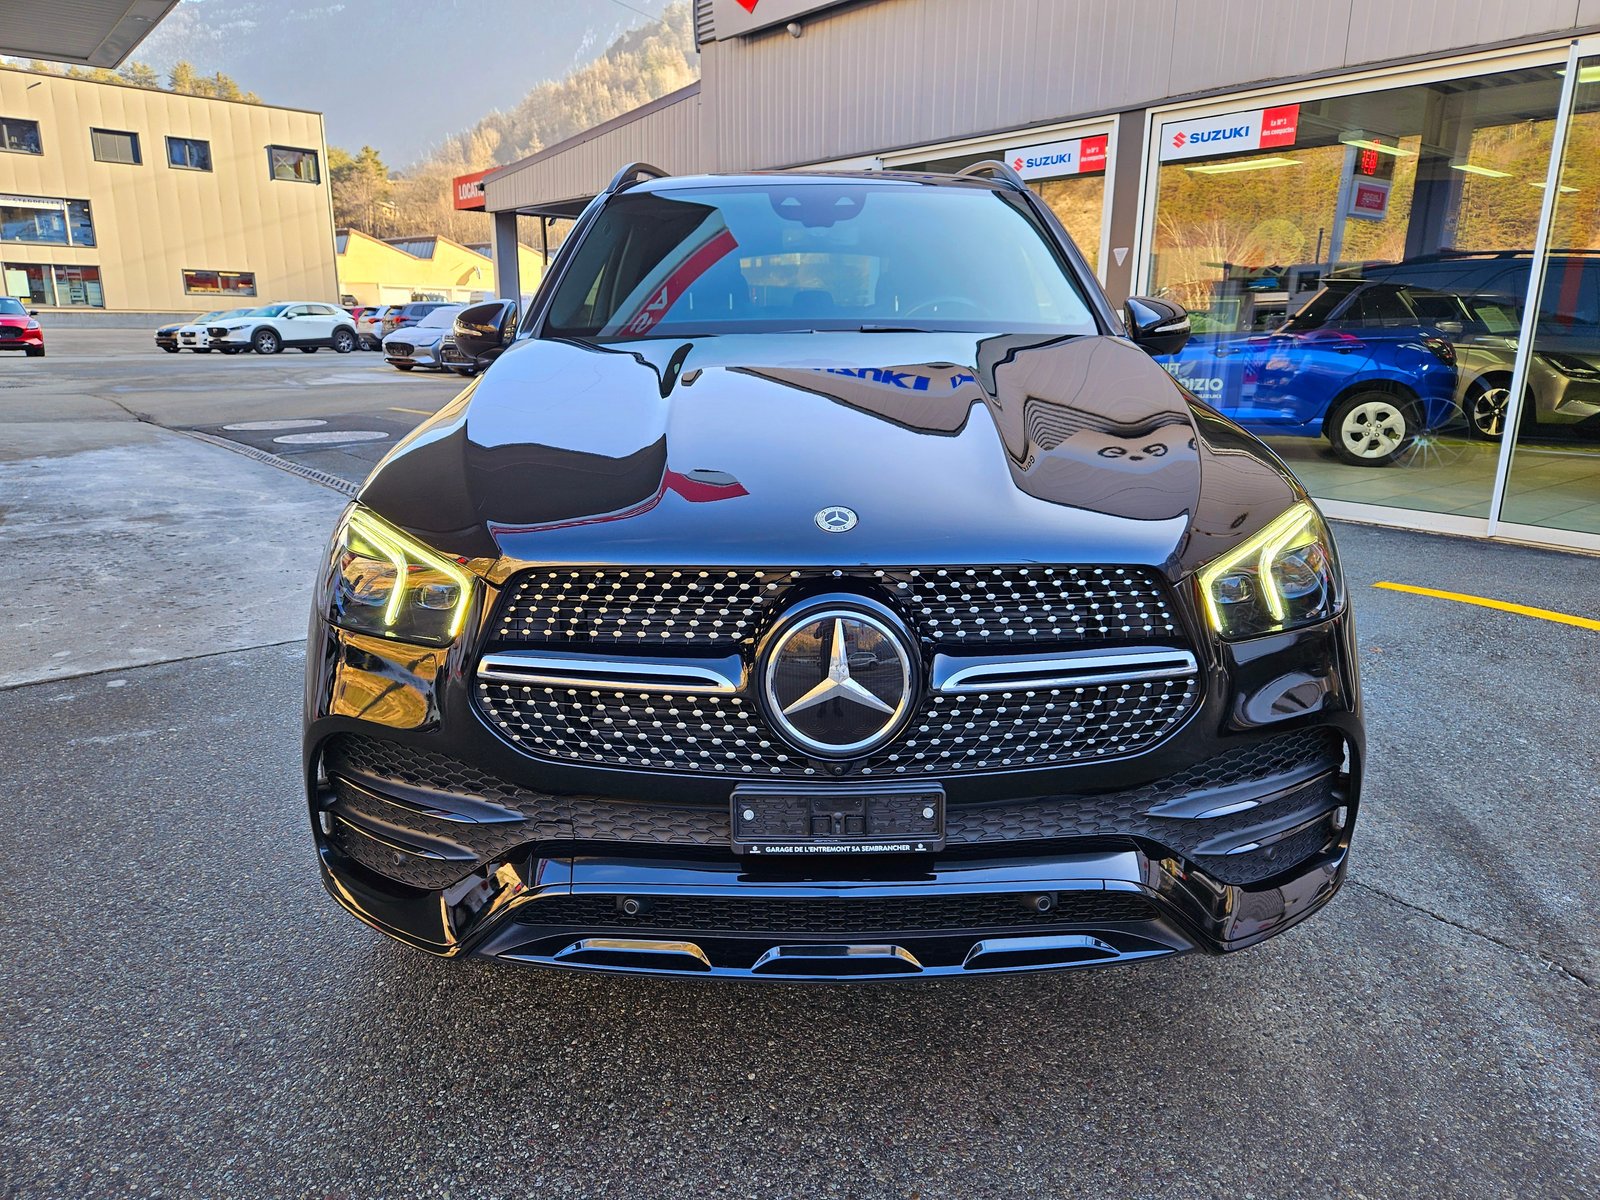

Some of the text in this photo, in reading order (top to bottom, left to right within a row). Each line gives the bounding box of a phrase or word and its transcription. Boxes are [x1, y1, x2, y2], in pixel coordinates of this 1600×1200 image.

[1189, 125, 1250, 144] SUZUKI
[1026, 153, 1072, 168] SUZUKI
[1178, 377, 1224, 391] DIZIO
[804, 845, 851, 853] L'ENTREMONT
[861, 844, 911, 853] SEMBRANCHER
